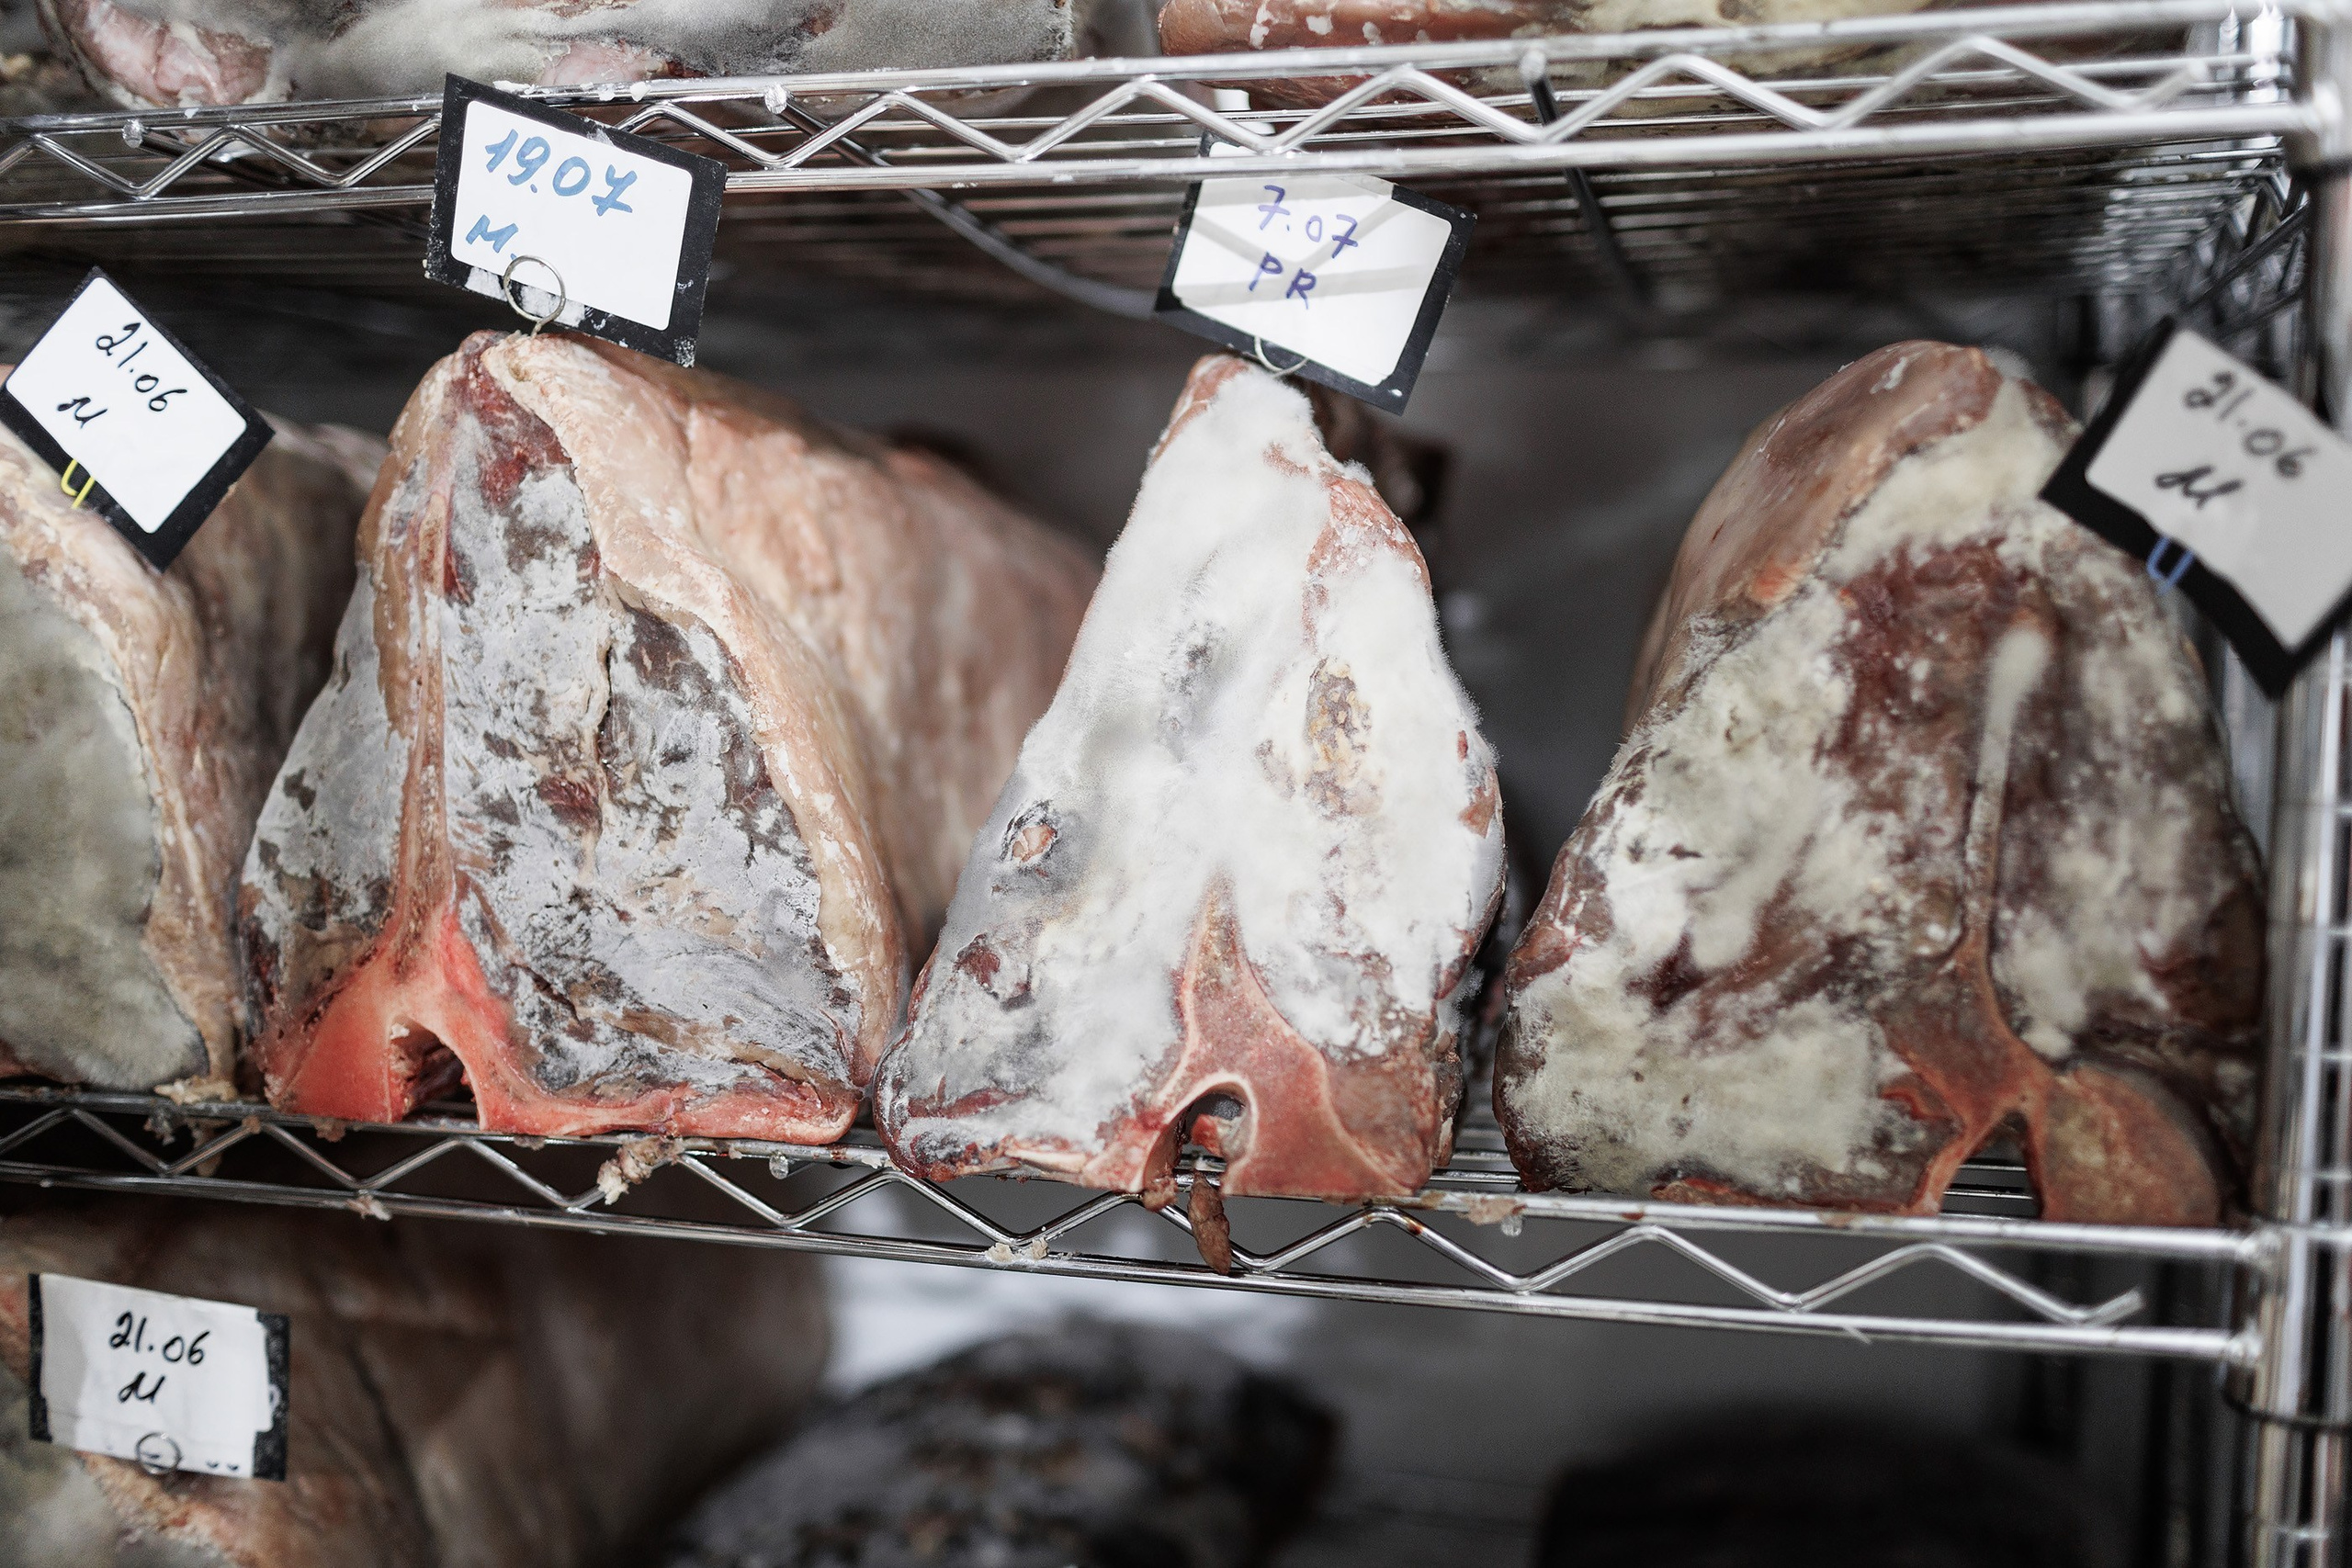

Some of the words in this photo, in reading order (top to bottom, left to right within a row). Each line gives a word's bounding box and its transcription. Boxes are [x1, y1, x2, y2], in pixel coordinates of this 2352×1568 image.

[484, 129, 638, 217] 19.07
[1258, 185, 1359, 259] 7.07
[1249, 252, 1317, 310] PR
[96, 321, 187, 412] 21.06
[2183, 371, 2319, 479] 21.06
[109, 1311, 210, 1365] 21.06
